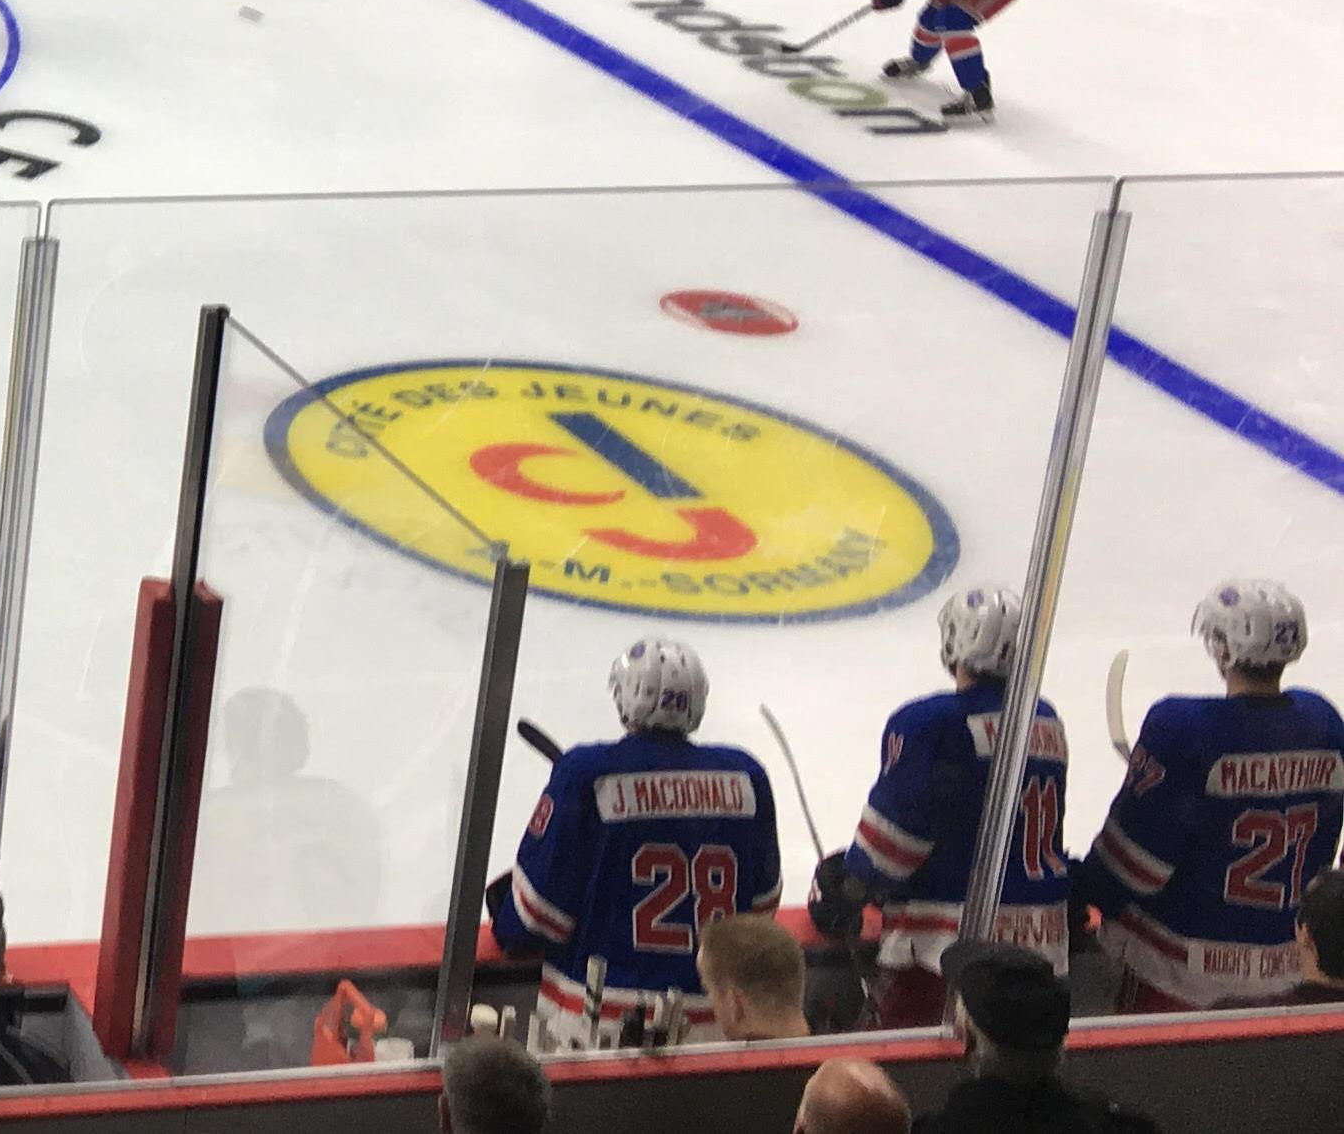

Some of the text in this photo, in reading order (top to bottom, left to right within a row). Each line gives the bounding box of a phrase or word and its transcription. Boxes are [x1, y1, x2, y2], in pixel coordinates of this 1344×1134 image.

[518, 380, 762, 443] JEUNES
[634, 775, 745, 813] MACDONALD
[1220, 755, 1338, 794] MACARTHUR
[1224, 803, 1320, 911] 27
[630, 842, 740, 954] 28
